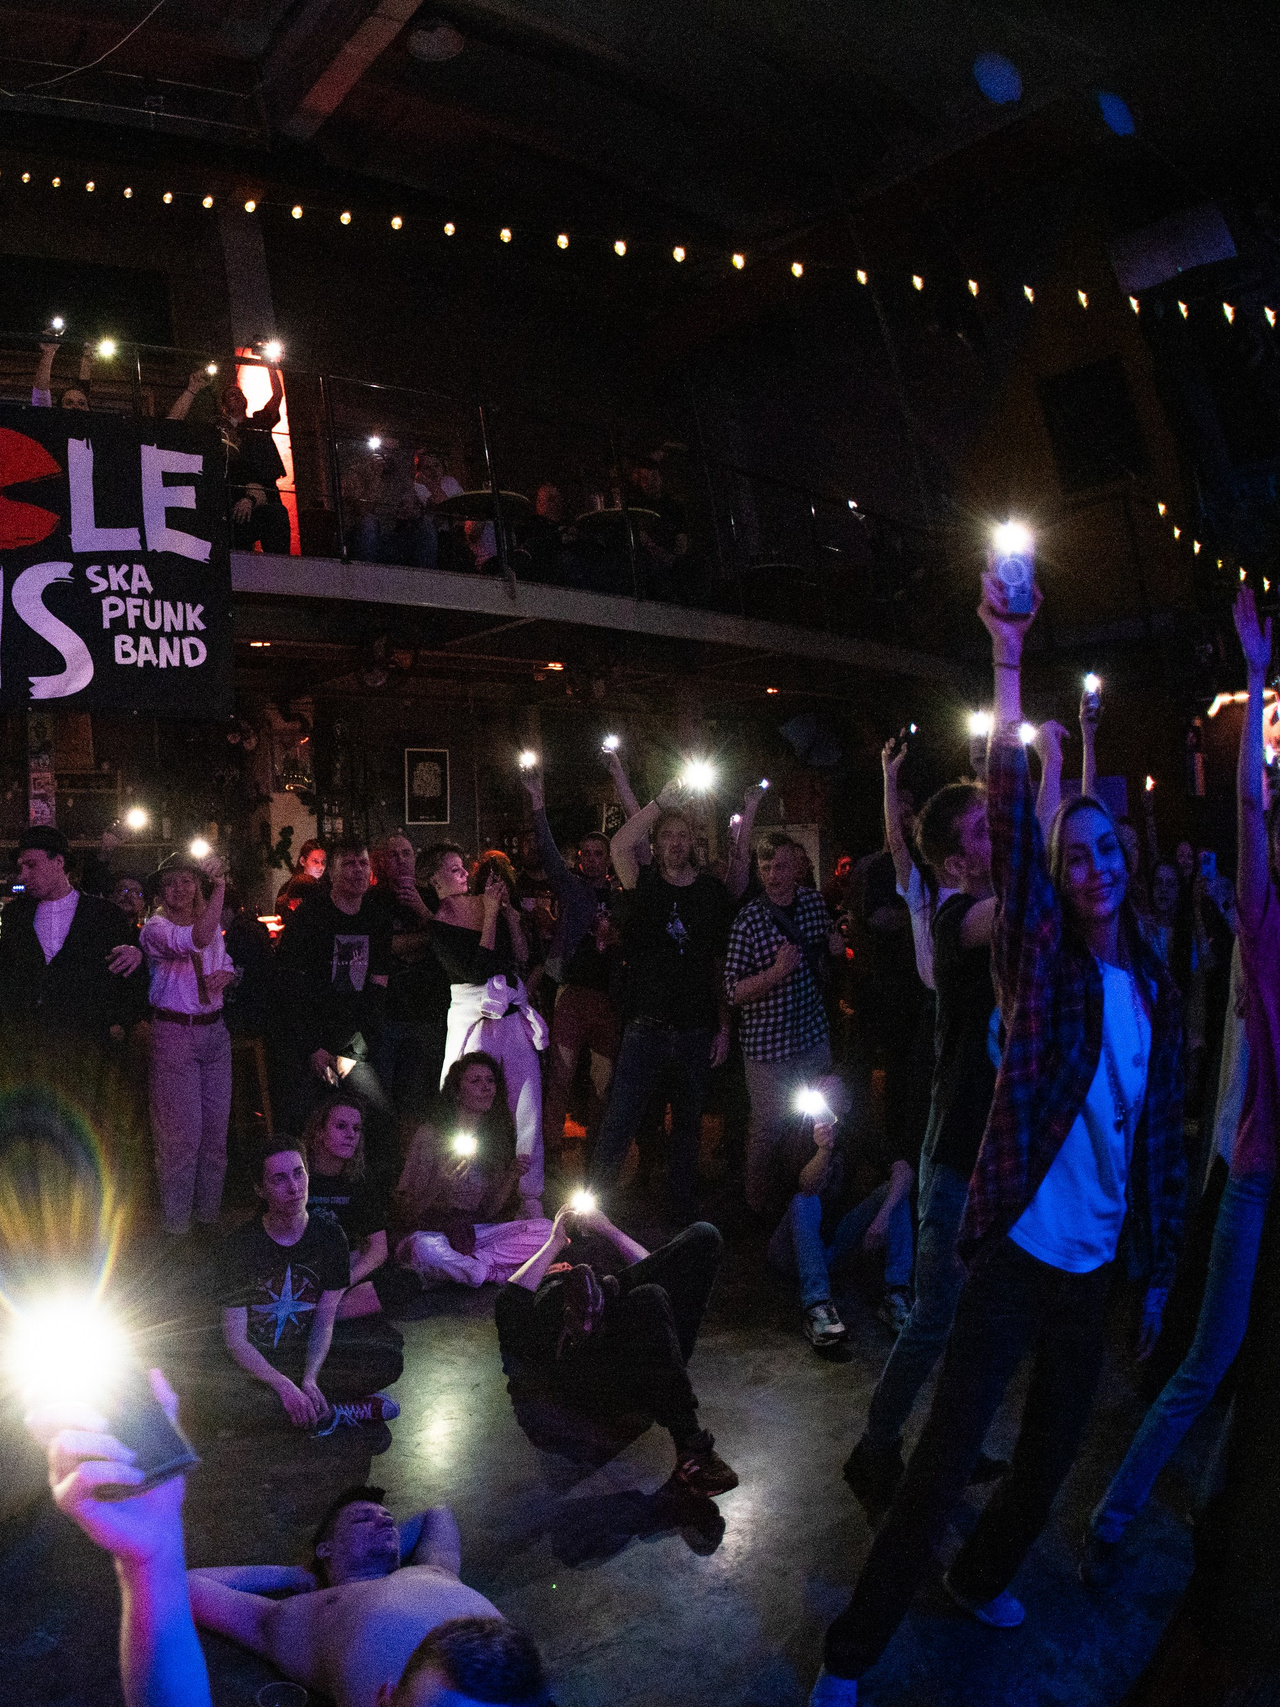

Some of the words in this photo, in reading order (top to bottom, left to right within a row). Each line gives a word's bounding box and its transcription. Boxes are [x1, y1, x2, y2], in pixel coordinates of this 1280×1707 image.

[85, 564, 153, 594] SKA
[102, 597, 206, 632] PFUNK
[114, 635, 208, 668] BAND
